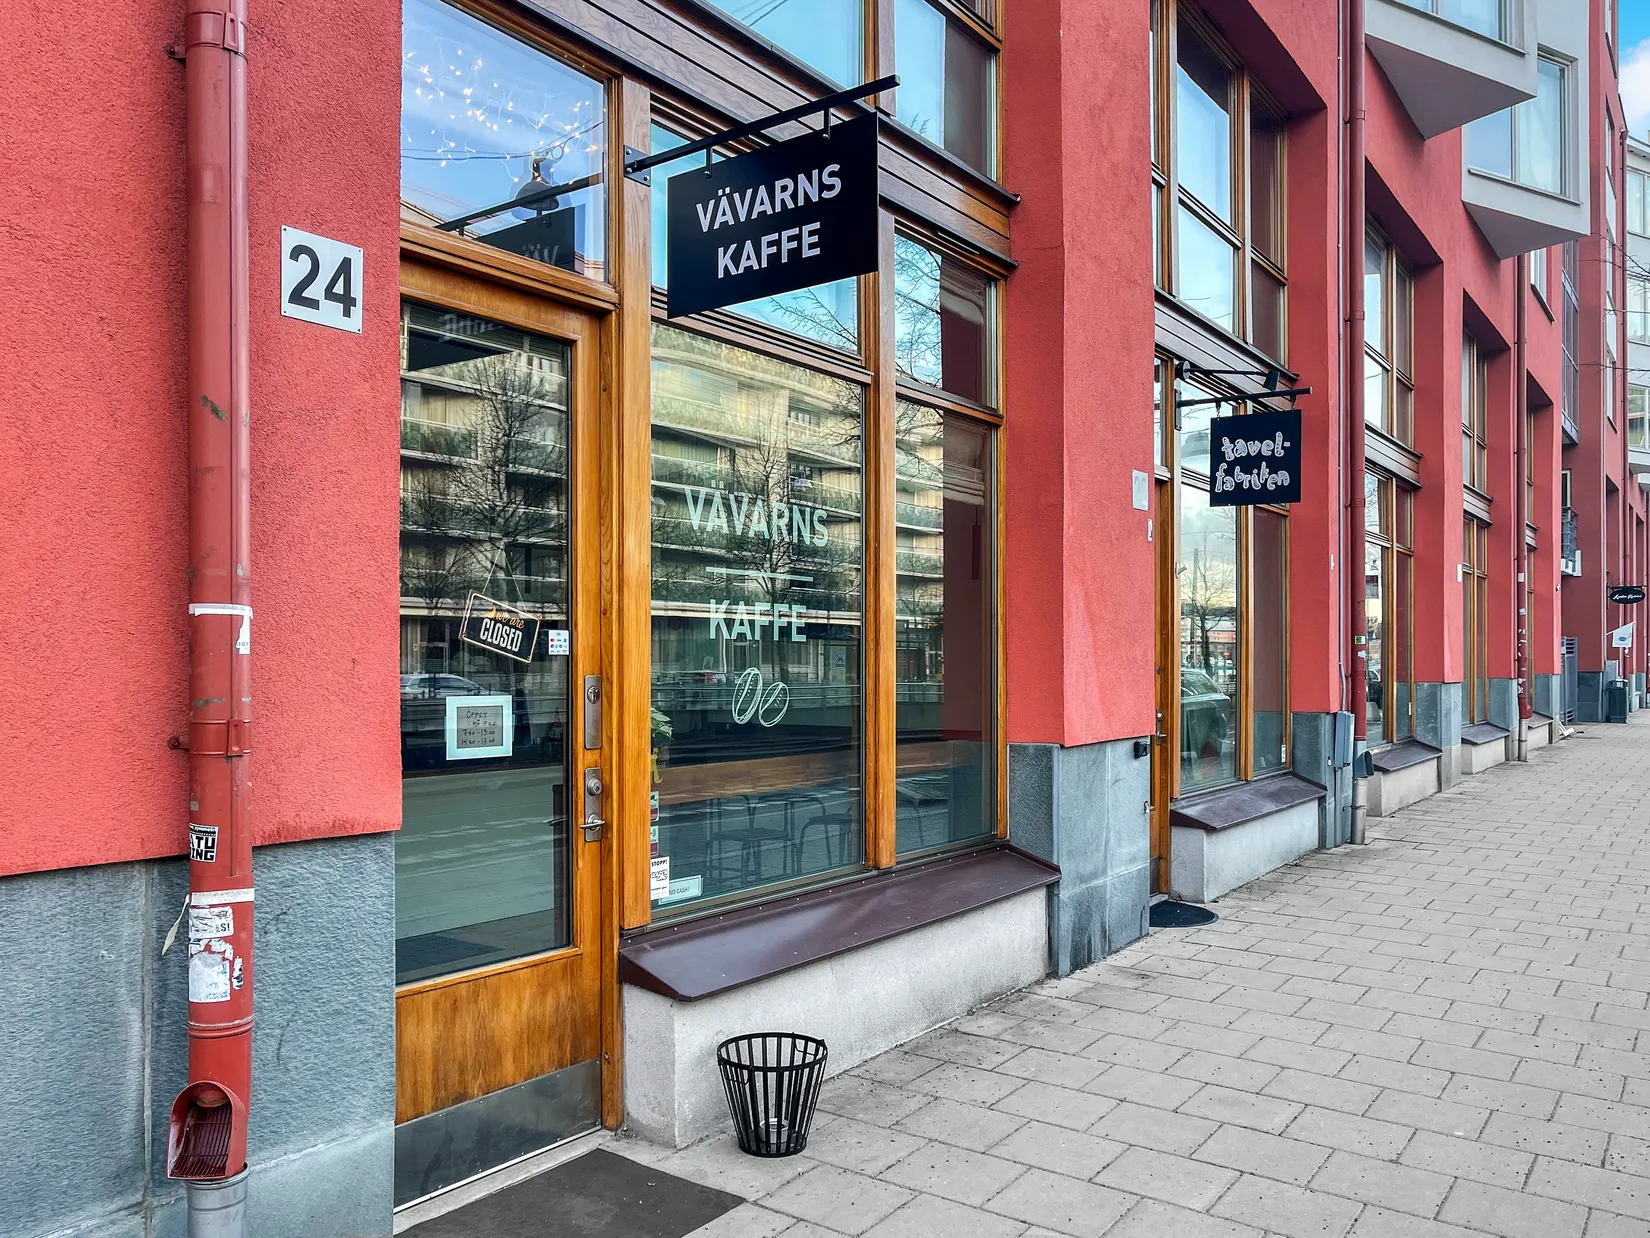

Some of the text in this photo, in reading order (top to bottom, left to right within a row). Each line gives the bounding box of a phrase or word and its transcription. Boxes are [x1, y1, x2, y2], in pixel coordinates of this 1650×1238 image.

[695, 163, 842, 233] VÄVARNS
[717, 221, 821, 279] KAFFE
[288, 244, 357, 318] 24
[1215, 461, 1290, 493] fabriken
[684, 479, 829, 547] VÄVARNS
[480, 618, 523, 652] CLOSED
[509, 617, 525, 629] are
[709, 598, 807, 642] KAFFE
